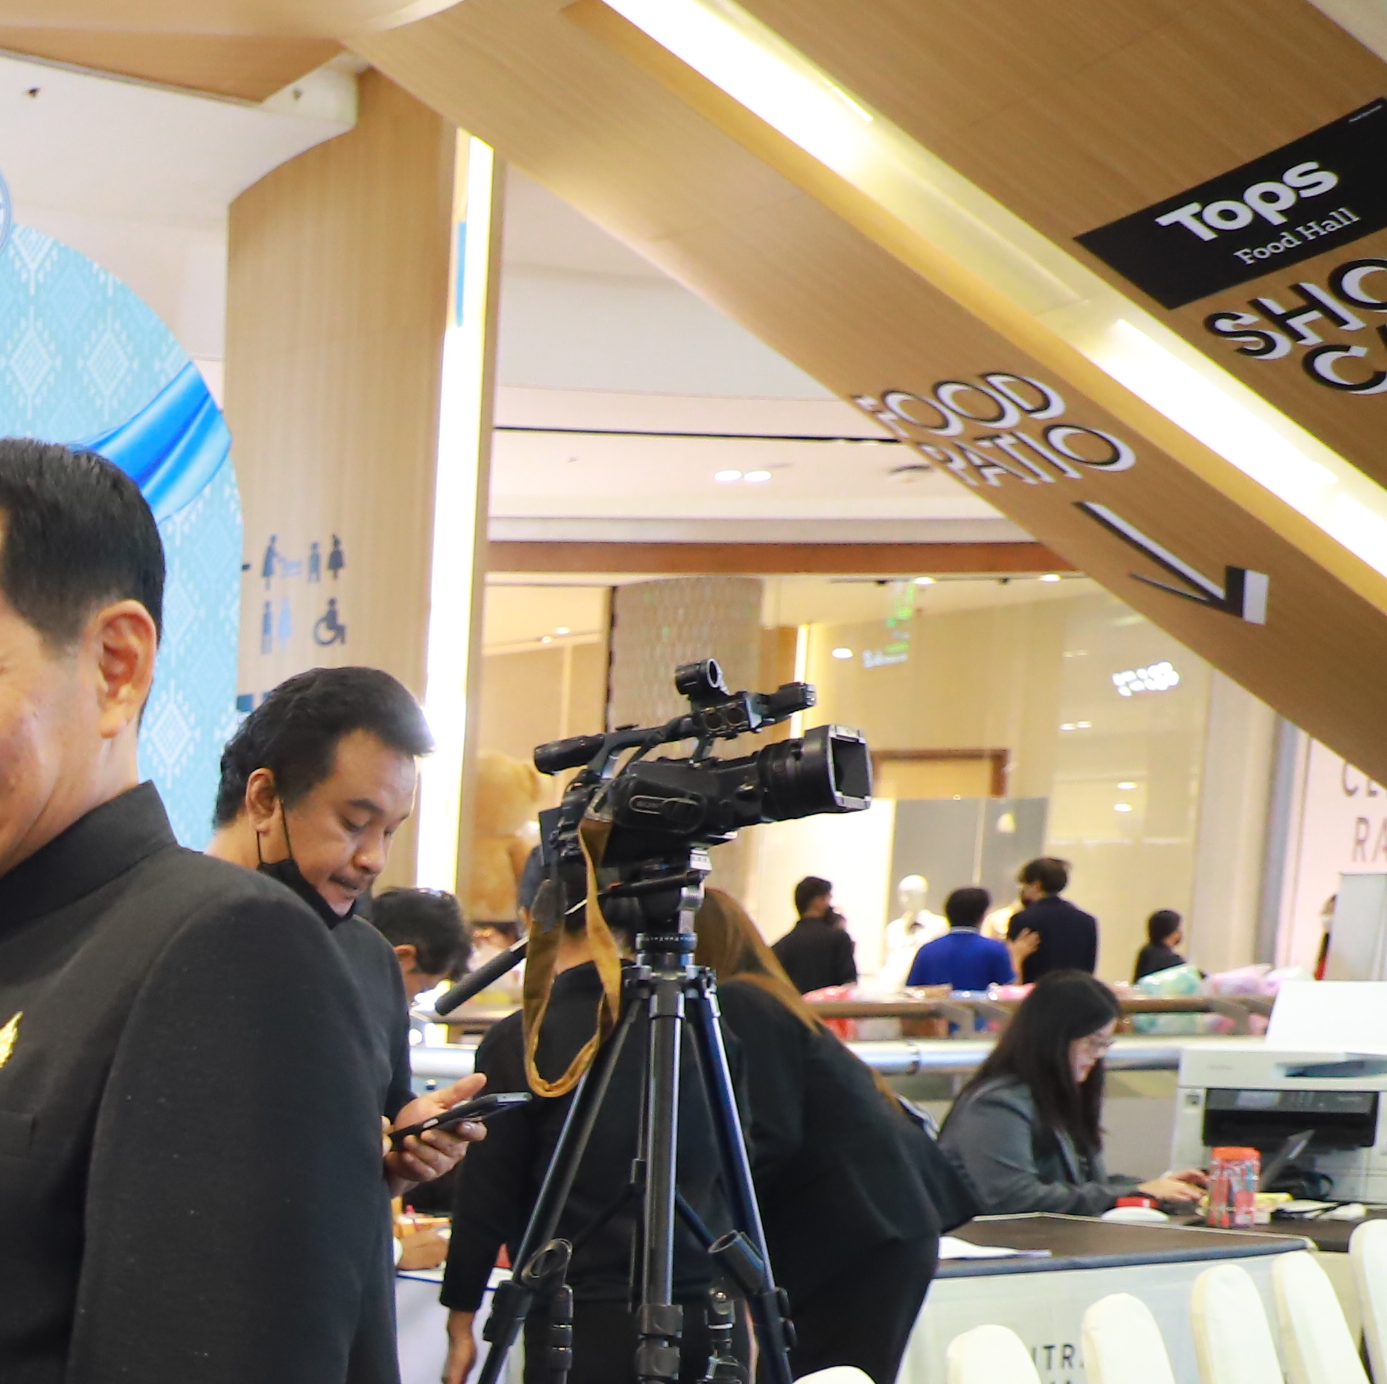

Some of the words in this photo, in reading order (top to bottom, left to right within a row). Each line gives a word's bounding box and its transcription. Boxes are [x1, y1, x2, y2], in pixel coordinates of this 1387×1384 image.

[1155, 161, 1339, 241] Tops
[1233, 231, 1303, 265] Food
[1295, 206, 1361, 241] Hall
[849, 372, 1066, 438] FOOD
